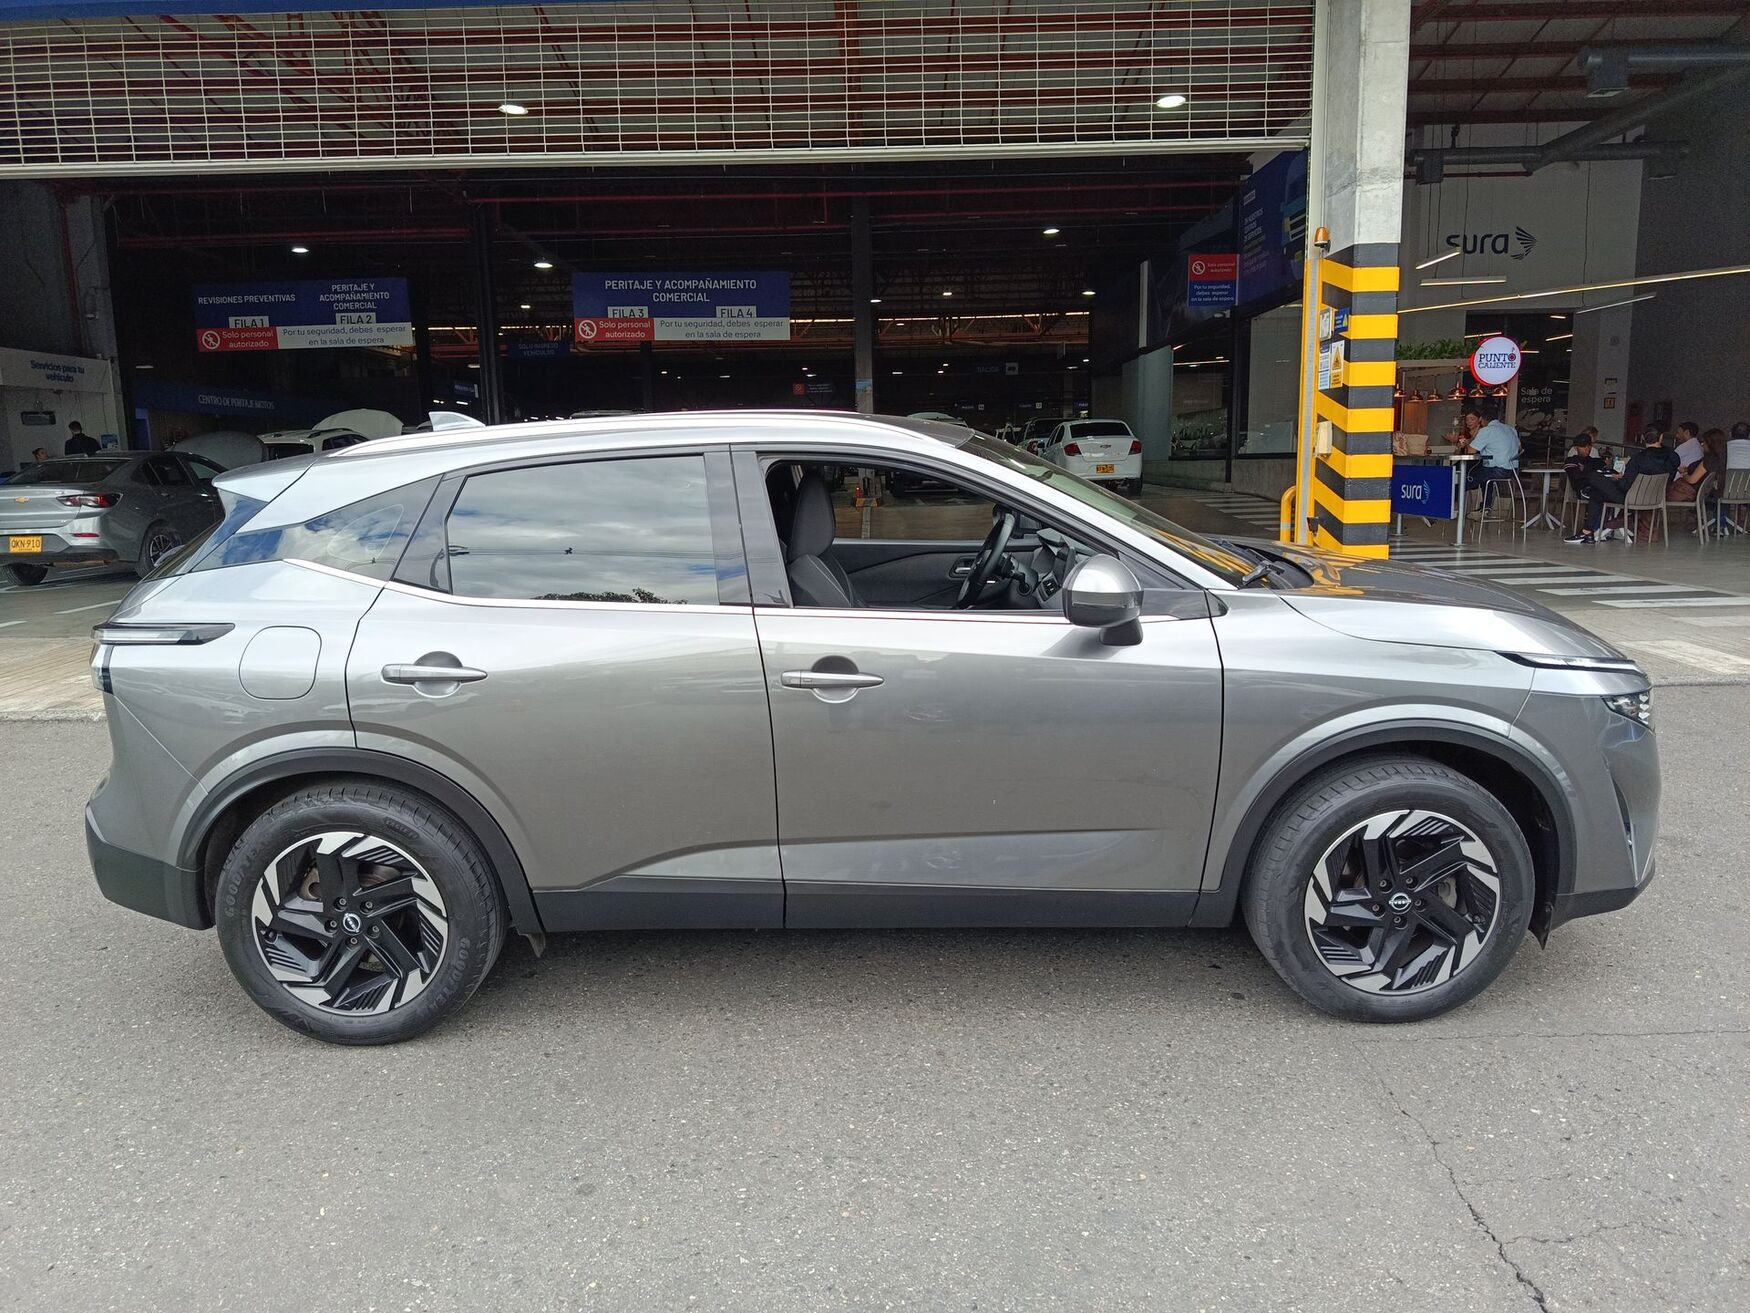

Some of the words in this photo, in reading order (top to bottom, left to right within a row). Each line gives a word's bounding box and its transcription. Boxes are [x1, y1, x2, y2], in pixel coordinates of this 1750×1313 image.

[1446, 234, 1509, 254] sura
[332, 283, 368, 292] PERITAJE
[369, 283, 375, 291] Y
[604, 280, 654, 290] PERITAJE
[656, 280, 662, 289] Y
[664, 278, 757, 289] ACOMPAÑAMIENTO
[198, 295, 244, 305] REVISIONES
[244, 294, 296, 303] PREVENTIVAS
[320, 291, 390, 302] ACOMPAÑAMIENTO
[653, 292, 710, 302] COMERCIAL
[333, 302, 378, 310] COMERCIAL
[612, 309, 636, 318] FILA
[638, 309, 644, 318] 3
[720, 308, 744, 318] FILA
[746, 308, 753, 318] 4
[234, 319, 257, 328] FILA
[260, 319, 264, 327] 1
[340, 316, 364, 324] FILA
[366, 315, 372, 324] 2
[618, 321, 651, 330] personal
[684, 320, 725, 329] seguridad,
[241, 331, 274, 339] personal
[307, 327, 348, 336] seguridad,
[376, 326, 406, 334] esperar
[1478, 353, 1516, 362] PUNTO
[30, 360, 62, 372] Servicios
[1521, 386, 1539, 395] Sala
[1541, 386, 1552, 395] de
[1401, 484, 1422, 500] sura
